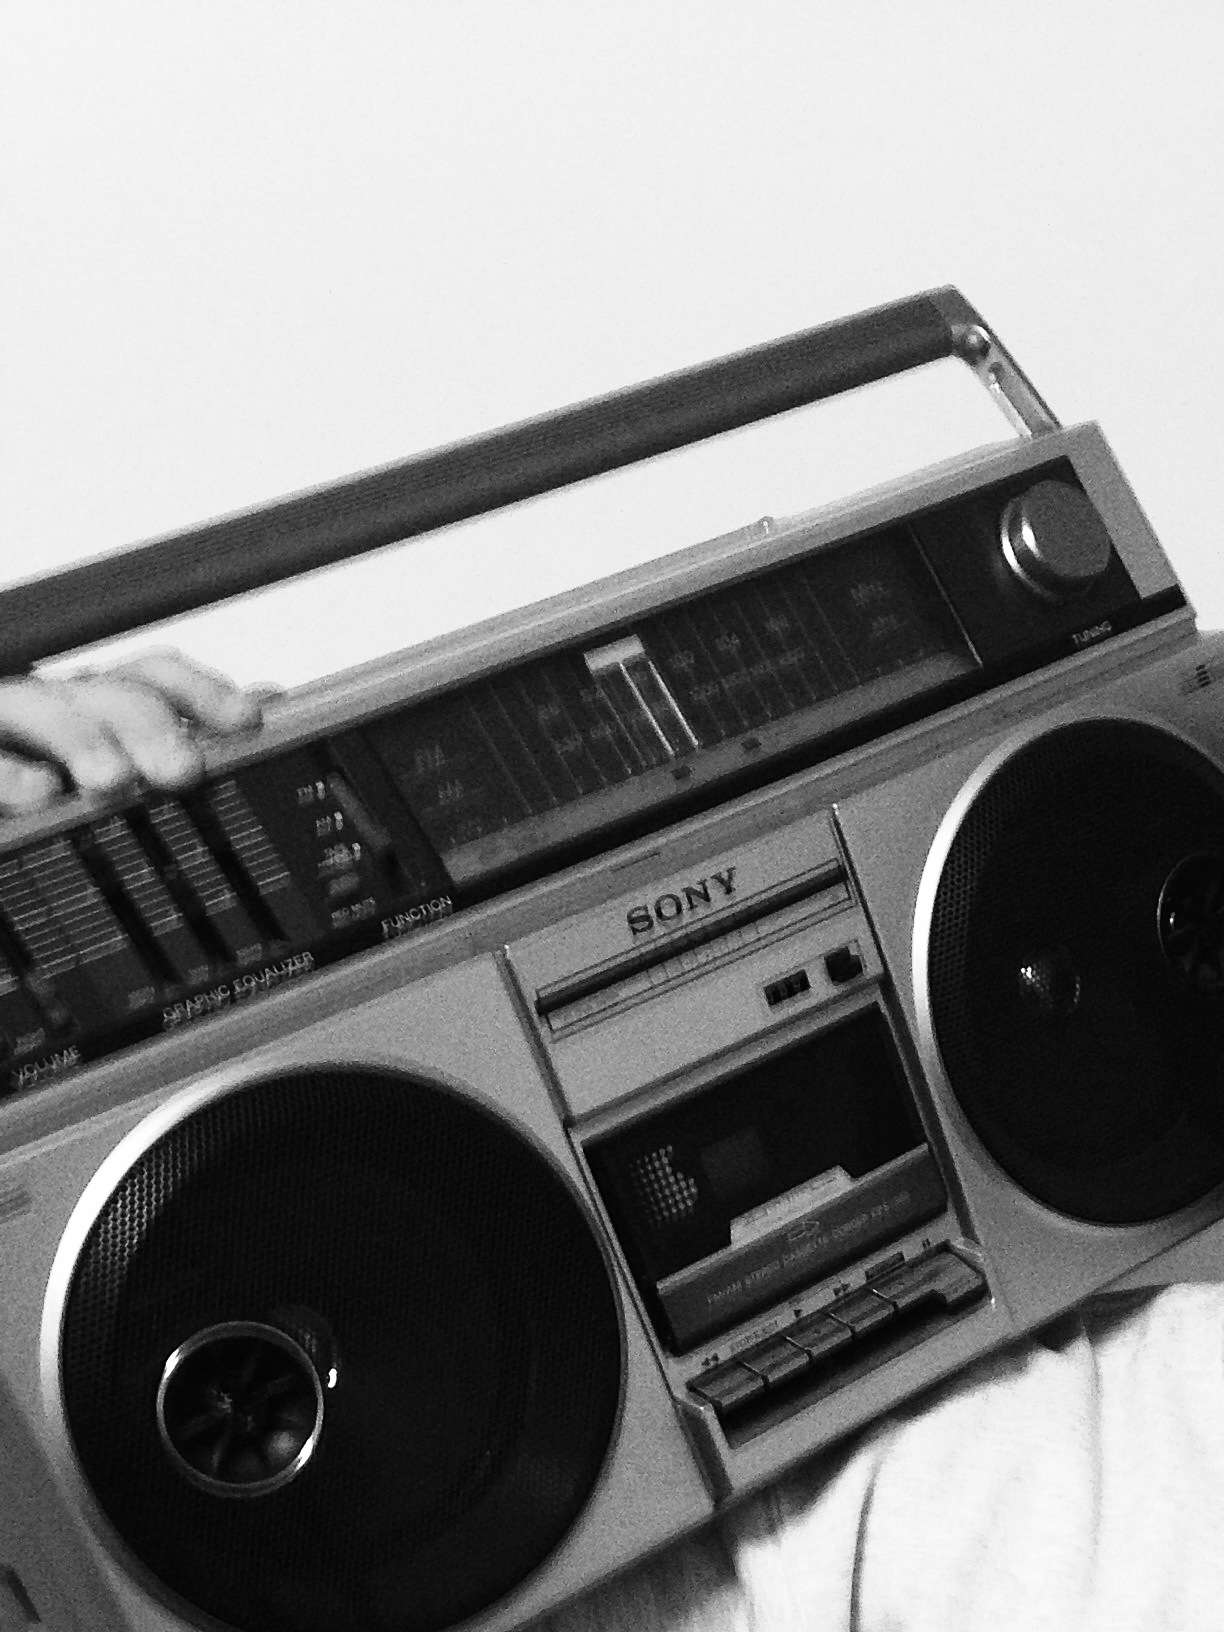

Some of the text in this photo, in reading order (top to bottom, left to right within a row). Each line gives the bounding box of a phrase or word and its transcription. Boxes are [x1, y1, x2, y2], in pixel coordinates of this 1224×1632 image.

[381, 895, 453, 933] FUNCTION
[627, 866, 736, 935] SONY
[163, 984, 231, 1022] GRAPHIC
[232, 951, 316, 995] EQUALIZER
[10, 1045, 81, 1086] VOLUME
